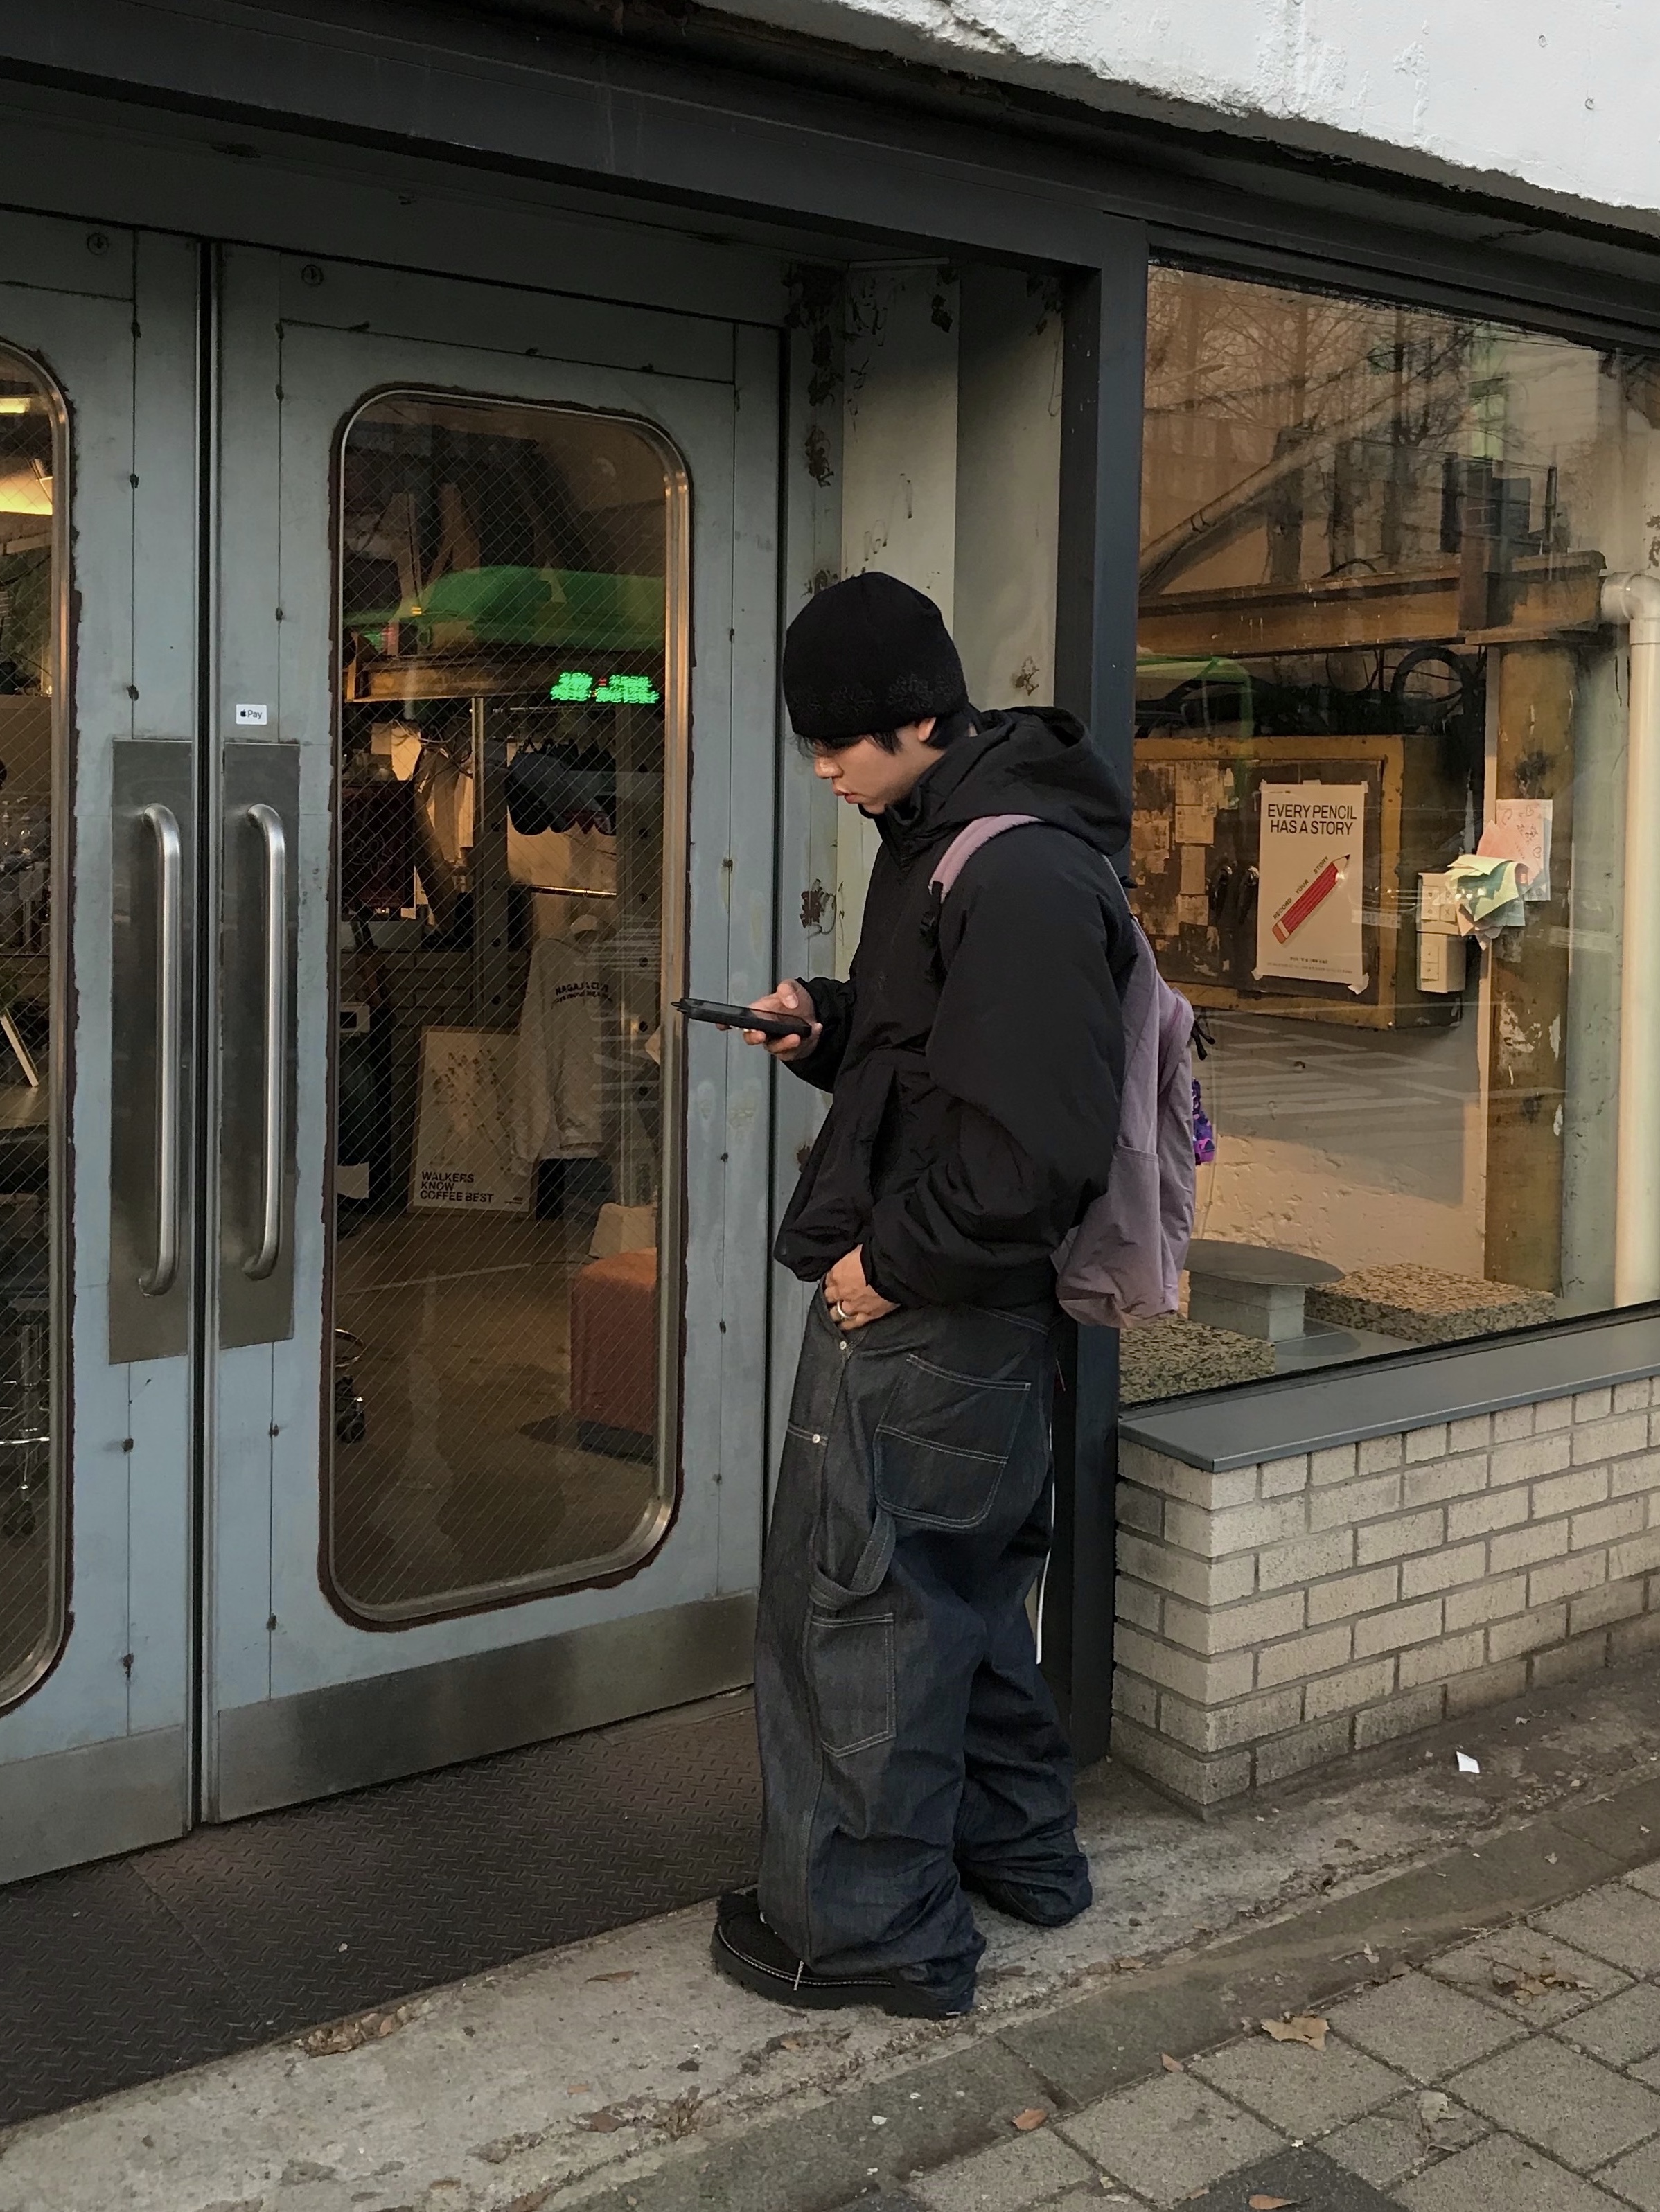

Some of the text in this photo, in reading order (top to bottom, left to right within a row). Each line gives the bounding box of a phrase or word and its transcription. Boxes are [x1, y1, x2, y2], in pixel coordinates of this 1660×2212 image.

[247, 709, 263, 719] Pay
[1267, 804, 1357, 820] EVERY PENCIL
[1270, 820, 1353, 835] HAS A STORY
[1295, 878, 1309, 894] YOUR
[1313, 856, 1329, 874] STORY
[421, 1171, 475, 1183] WALKERS
[421, 1181, 455, 1192] KNOW
[420, 1190, 463, 1201] COFFEE
[465, 1192, 494, 1203] BEST
